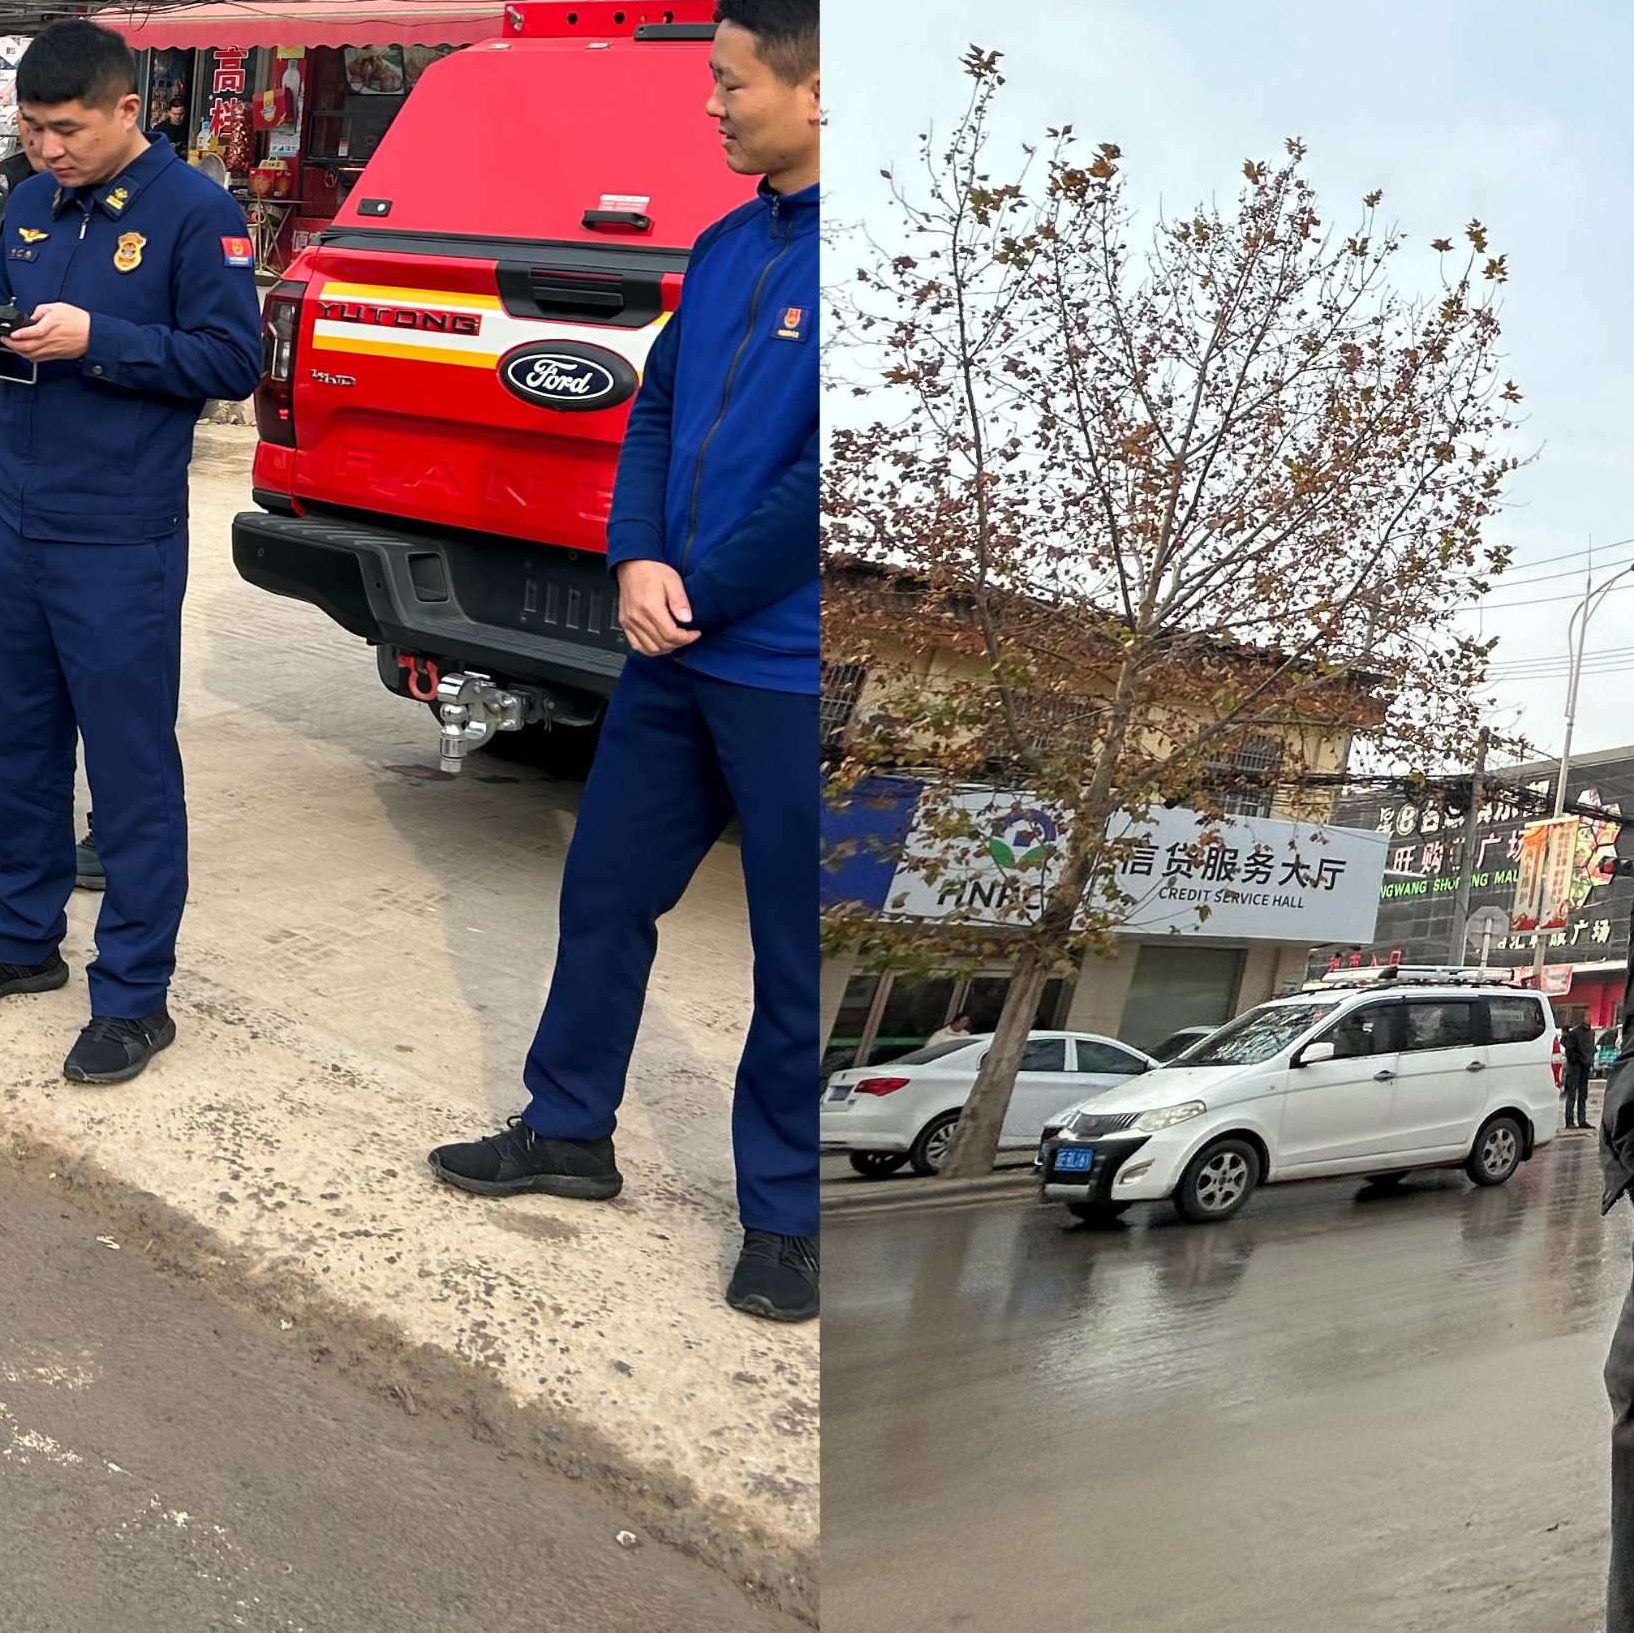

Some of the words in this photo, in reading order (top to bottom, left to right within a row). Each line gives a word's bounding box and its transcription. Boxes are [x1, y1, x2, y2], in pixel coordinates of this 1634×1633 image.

[317, 301, 479, 335] YUTONG
[525, 357, 593, 395] Ford
[1119, 841, 1347, 892] 信贷服务大厅
[1157, 886, 1212, 904] CREDIT
[1213, 889, 1270, 907] SERVICE
[1272, 893, 1305, 910] HALL
